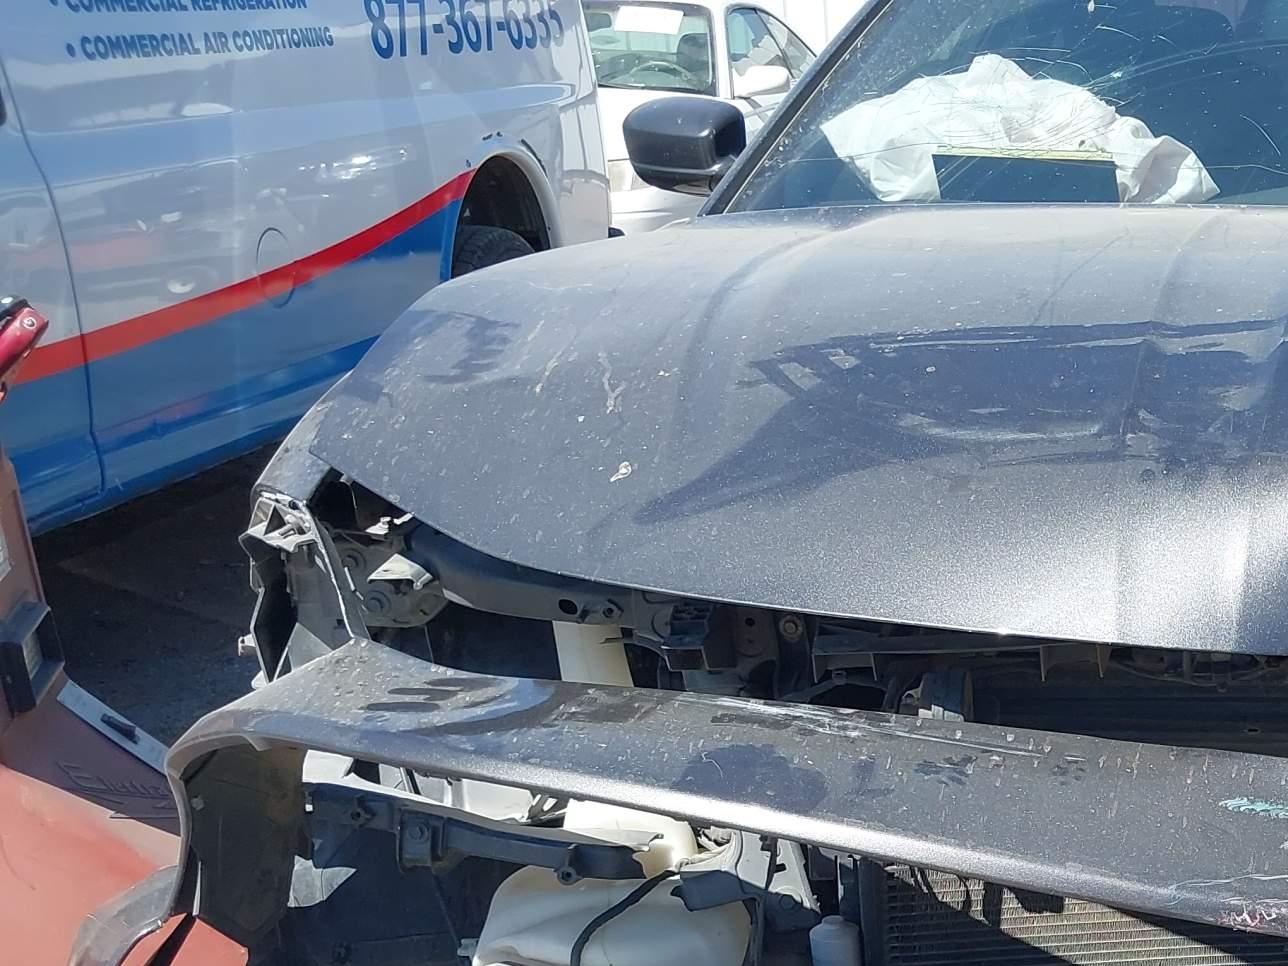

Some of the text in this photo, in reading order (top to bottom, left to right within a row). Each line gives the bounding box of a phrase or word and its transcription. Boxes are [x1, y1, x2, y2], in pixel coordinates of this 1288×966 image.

[80, 26, 335, 61] COMMERCIAL AIR CONDITIONING
[364, 0, 564, 60] 877-367-6335
